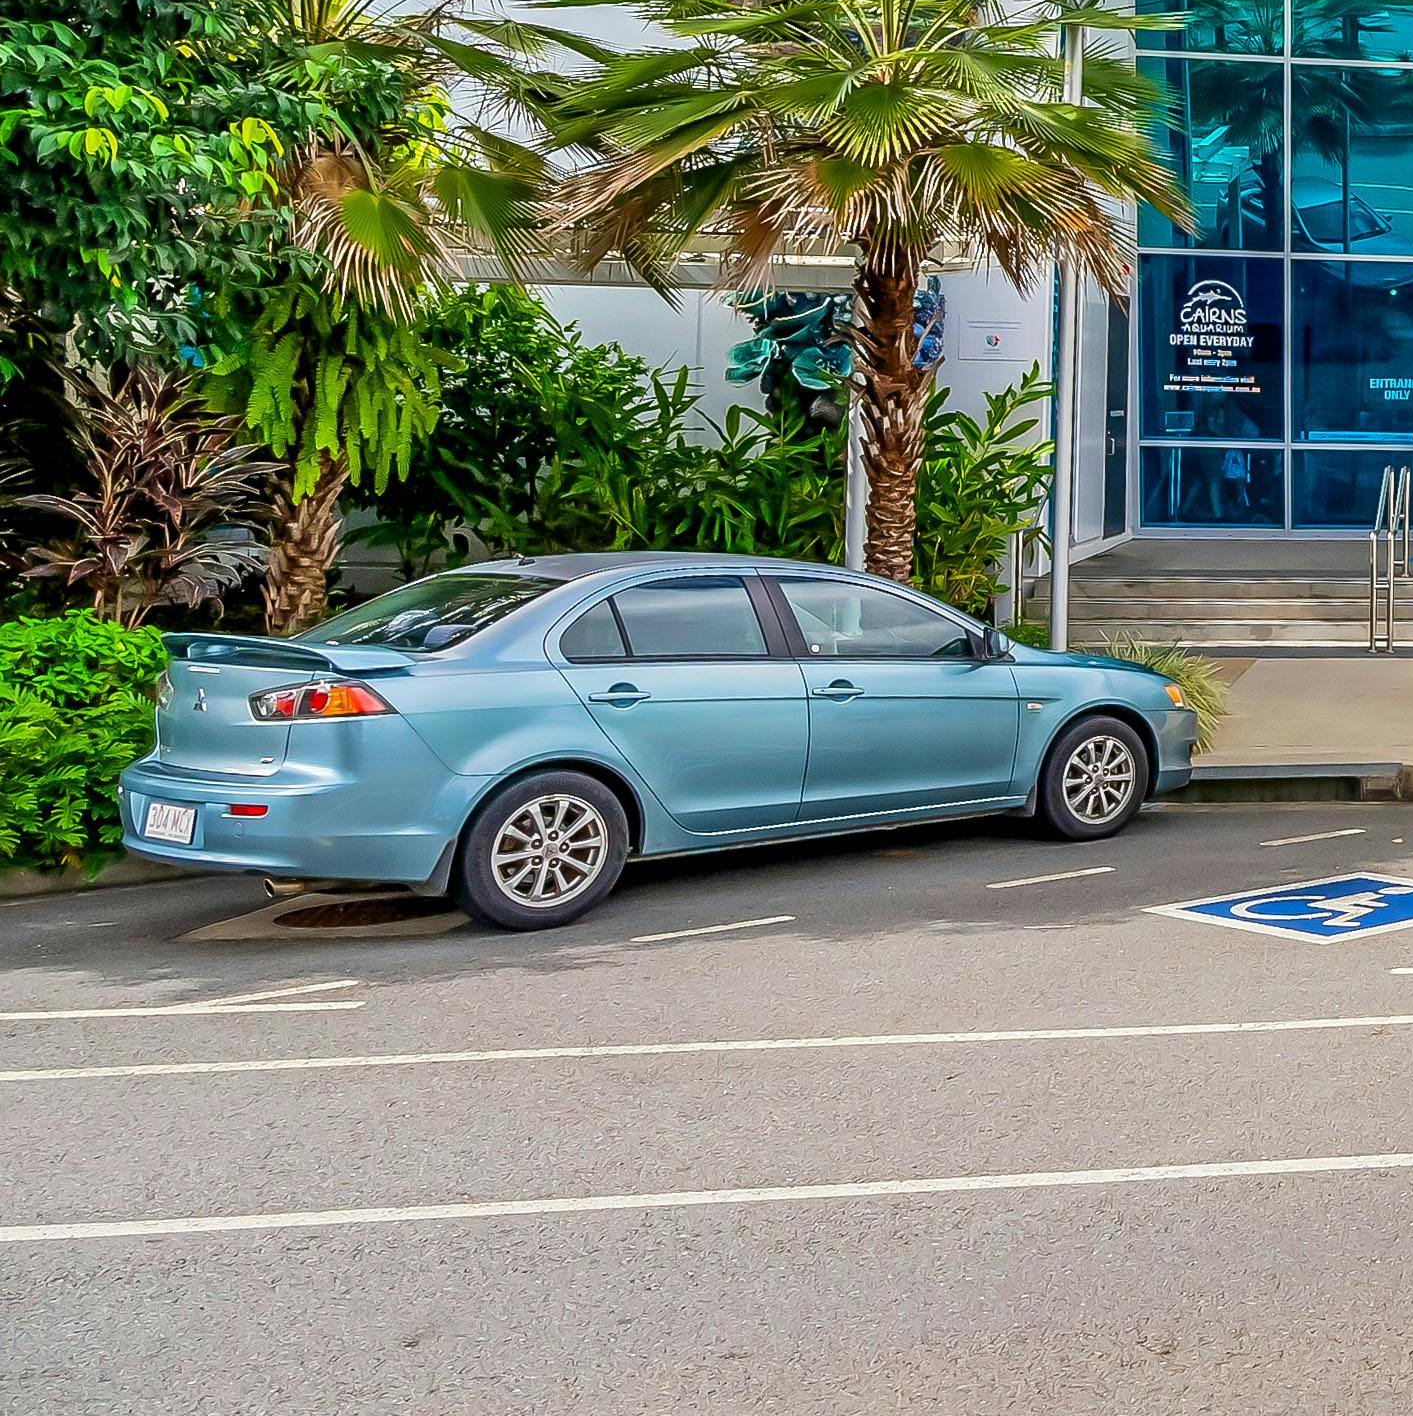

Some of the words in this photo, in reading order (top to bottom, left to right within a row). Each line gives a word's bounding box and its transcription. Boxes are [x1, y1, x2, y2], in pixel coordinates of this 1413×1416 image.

[1180, 306, 1247, 324] CAIRNS
[1181, 324, 1244, 333] AQUARIUM
[1169, 334, 1197, 346] OPEN
[1200, 335, 1254, 347] EVERYDAY
[1384, 390, 1411, 400] ONLY
